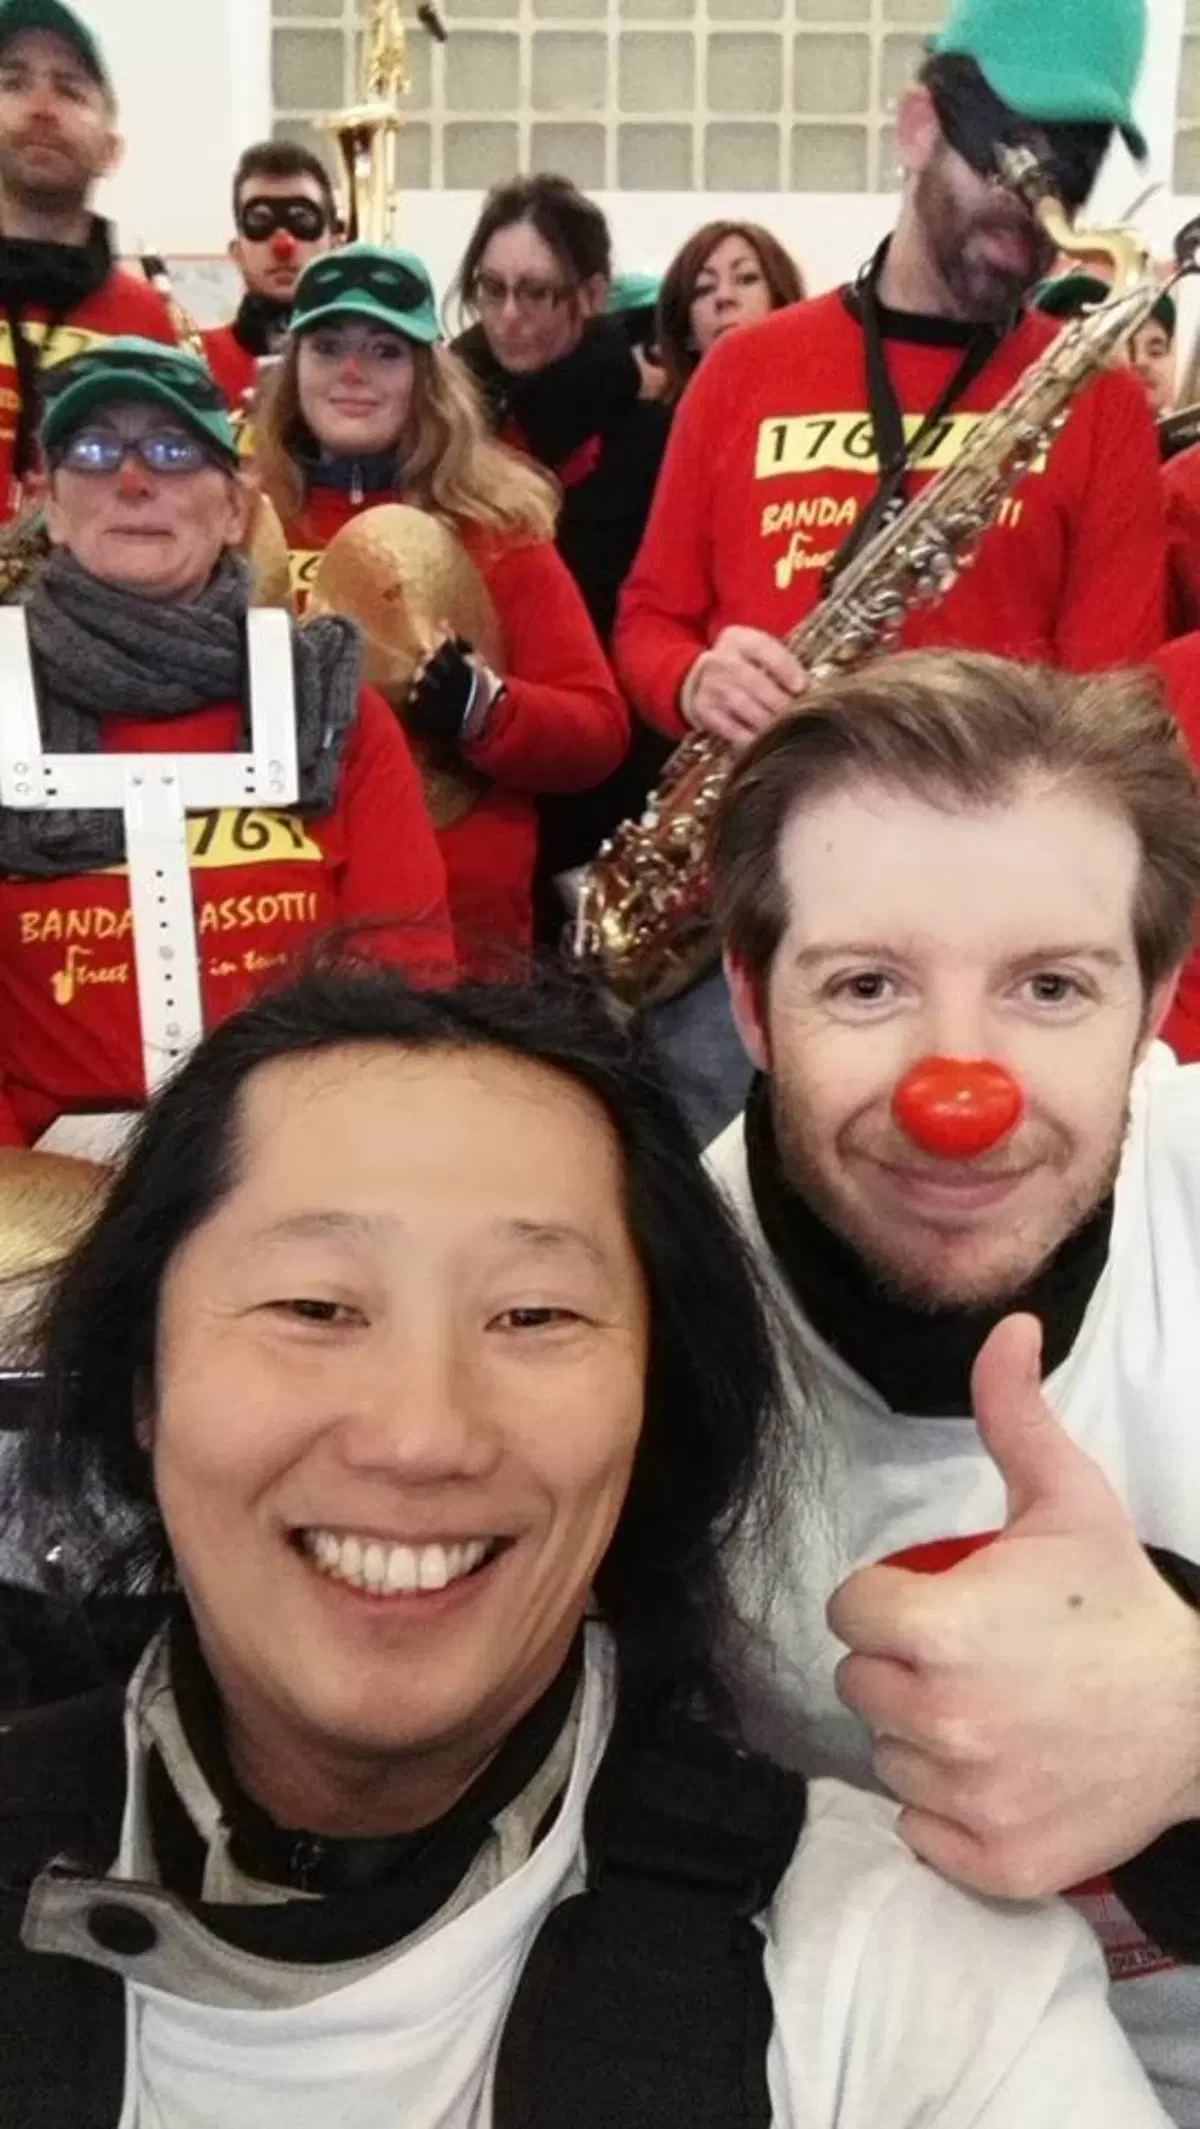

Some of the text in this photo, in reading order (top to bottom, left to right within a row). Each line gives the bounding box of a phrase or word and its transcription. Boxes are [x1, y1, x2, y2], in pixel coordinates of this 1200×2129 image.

[760, 496, 858, 538] BANDA
[20, 891, 318, 944] BANDA ASSOTTI
